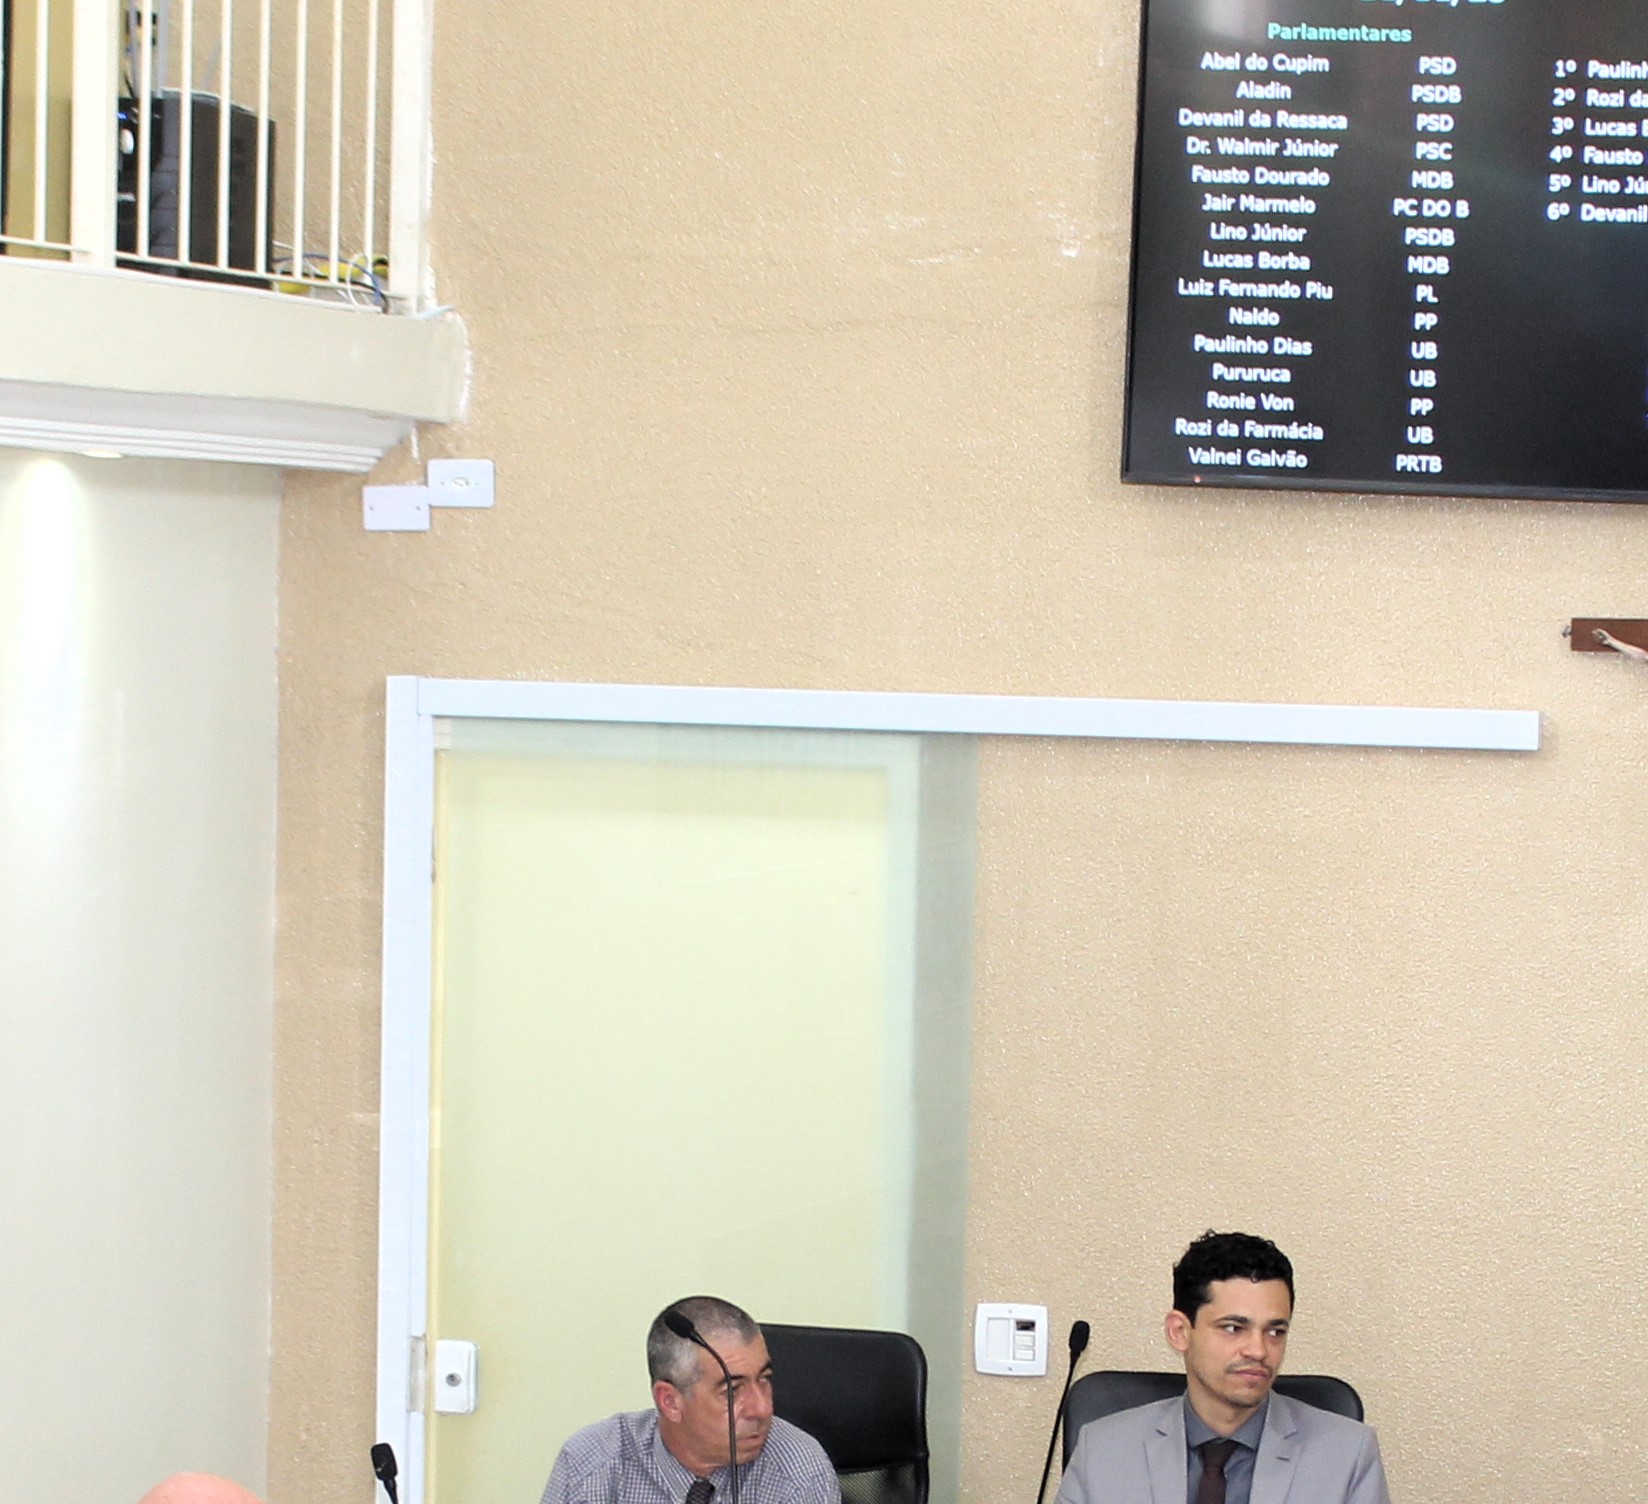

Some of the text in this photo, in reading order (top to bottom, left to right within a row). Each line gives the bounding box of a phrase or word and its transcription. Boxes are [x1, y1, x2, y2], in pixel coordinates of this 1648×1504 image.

[1267, 22, 1411, 42] Parlamentares
[1200, 51, 1329, 75] Abel do Cupim
[1419, 55, 1456, 76] PSD
[1236, 80, 1291, 100] Aladin
[1411, 84, 1461, 104] PSDB
[1586, 88, 1624, 107] Rozi
[1179, 108, 1347, 130] Devanil da Ressaca
[1416, 113, 1454, 133] PSD
[1584, 117, 1637, 137] Lucas
[1186, 135, 1338, 158] Dr. Walmir Júnior
[1416, 141, 1452, 161] PSC
[1583, 145, 1644, 165] Fausto
[1191, 164, 1330, 187] Fausto Dourado
[1411, 170, 1453, 189] MDB
[1581, 175, 1620, 194] Lino
[1202, 193, 1316, 214] Jair Marmelo
[1393, 198, 1469, 219] PC DO B
[1580, 203, 1648, 223] Devanil
[1210, 221, 1307, 242] Lino Júnior
[1404, 226, 1455, 247] PSDB
[1203, 249, 1310, 271] Lucas Borba
[1407, 255, 1449, 275] MDB
[1178, 277, 1333, 300] Luiz Fernando Piu
[1416, 284, 1438, 303] PL
[1229, 307, 1280, 326] Naldo
[1414, 313, 1438, 331] PP
[1194, 334, 1312, 356] Paulinho Dias
[1411, 341, 1438, 360] UB
[1212, 362, 1291, 383] Pururuca
[1410, 369, 1436, 388] UB
[1206, 391, 1294, 411] Ronie Von
[1410, 397, 1433, 416] PP
[1175, 417, 1323, 440] Rozi da Farmácia
[1407, 426, 1433, 444] UB
[1189, 447, 1307, 468] Valnei Galvão
[1396, 454, 1442, 473] PRTB
